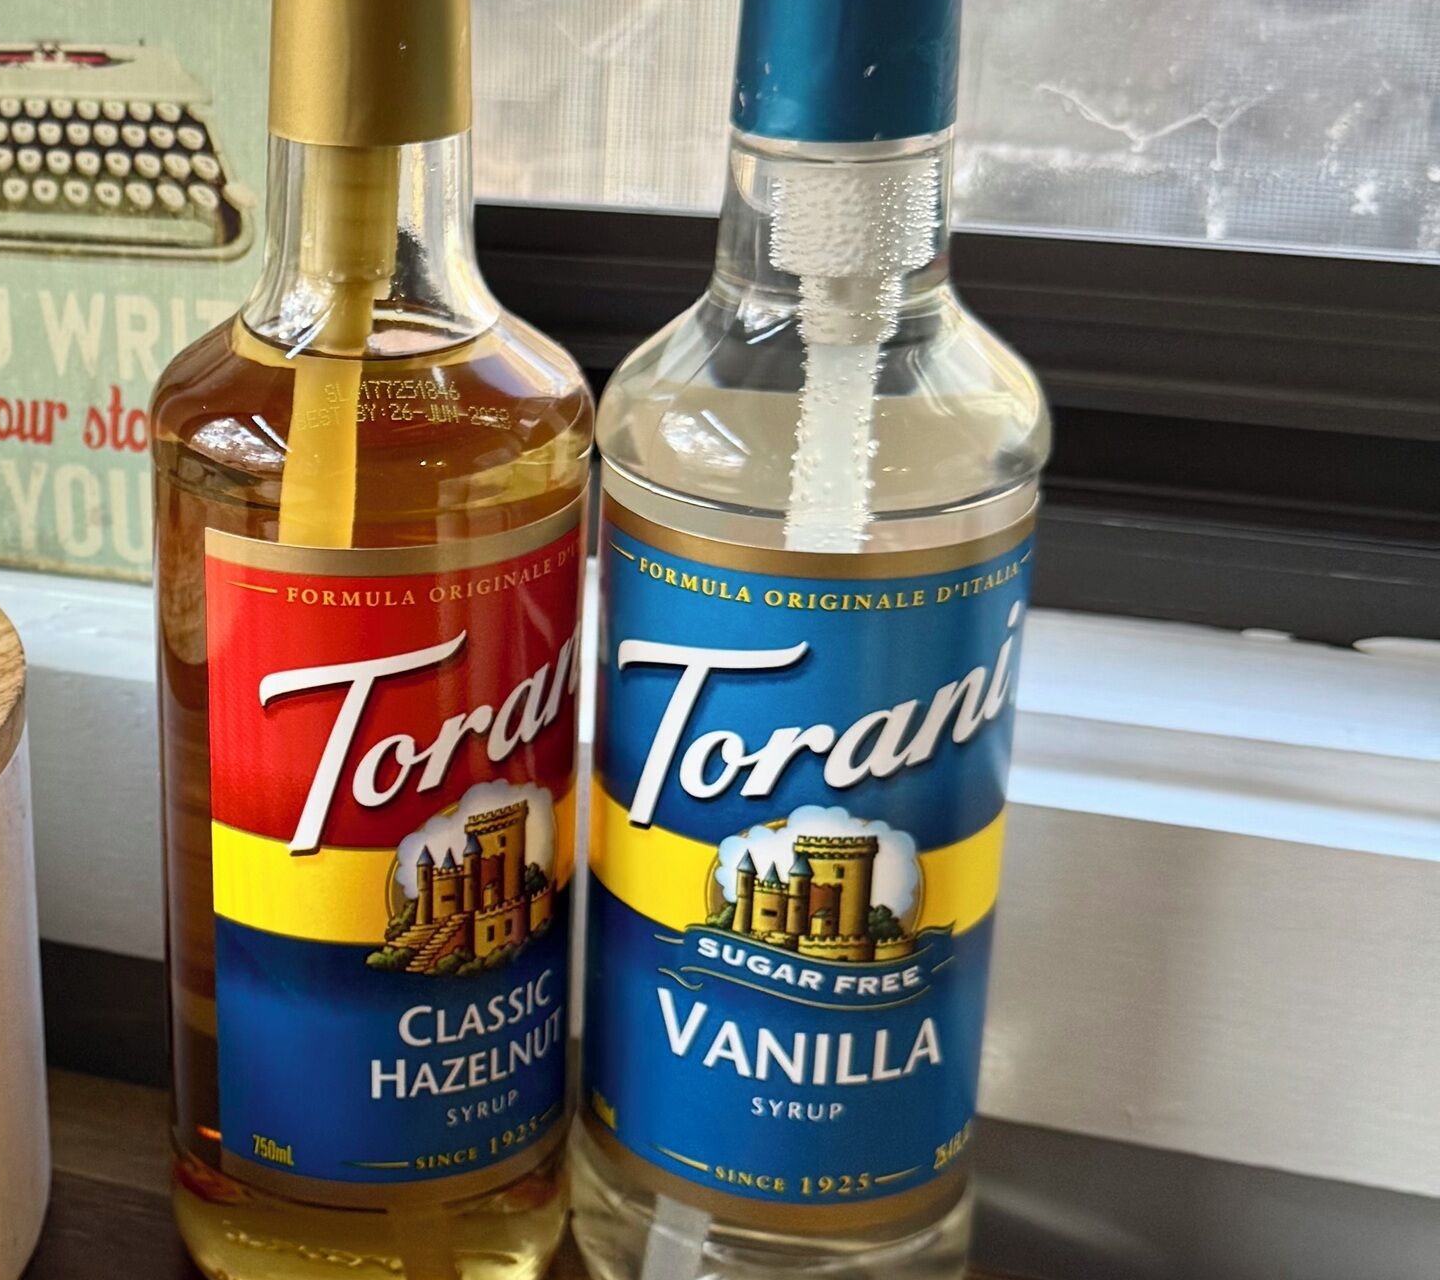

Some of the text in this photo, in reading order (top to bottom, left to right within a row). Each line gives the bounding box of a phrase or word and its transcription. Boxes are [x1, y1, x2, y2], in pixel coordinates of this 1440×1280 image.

[84, 386, 150, 453] sto
[0, 459, 150, 565] YOU
[286, 558, 552, 608] FORMULA ORIGINALE
[639, 557, 1019, 611] FORMULA ORIGINALE D'ITALIA
[259, 628, 581, 856] Toran
[618, 600, 1023, 829] Torani
[697, 938, 921, 995] SUGAR FREE
[398, 969, 553, 1047] CLASSIC
[657, 986, 942, 1086] VANILLA
[370, 1006, 562, 1100] HAZELNUT
[447, 1089, 519, 1127] SYRUP
[750, 1096, 846, 1121] SYRUP
[416, 1115, 538, 1169] SINCE 1925
[714, 1164, 871, 1196] SINCE 1925
